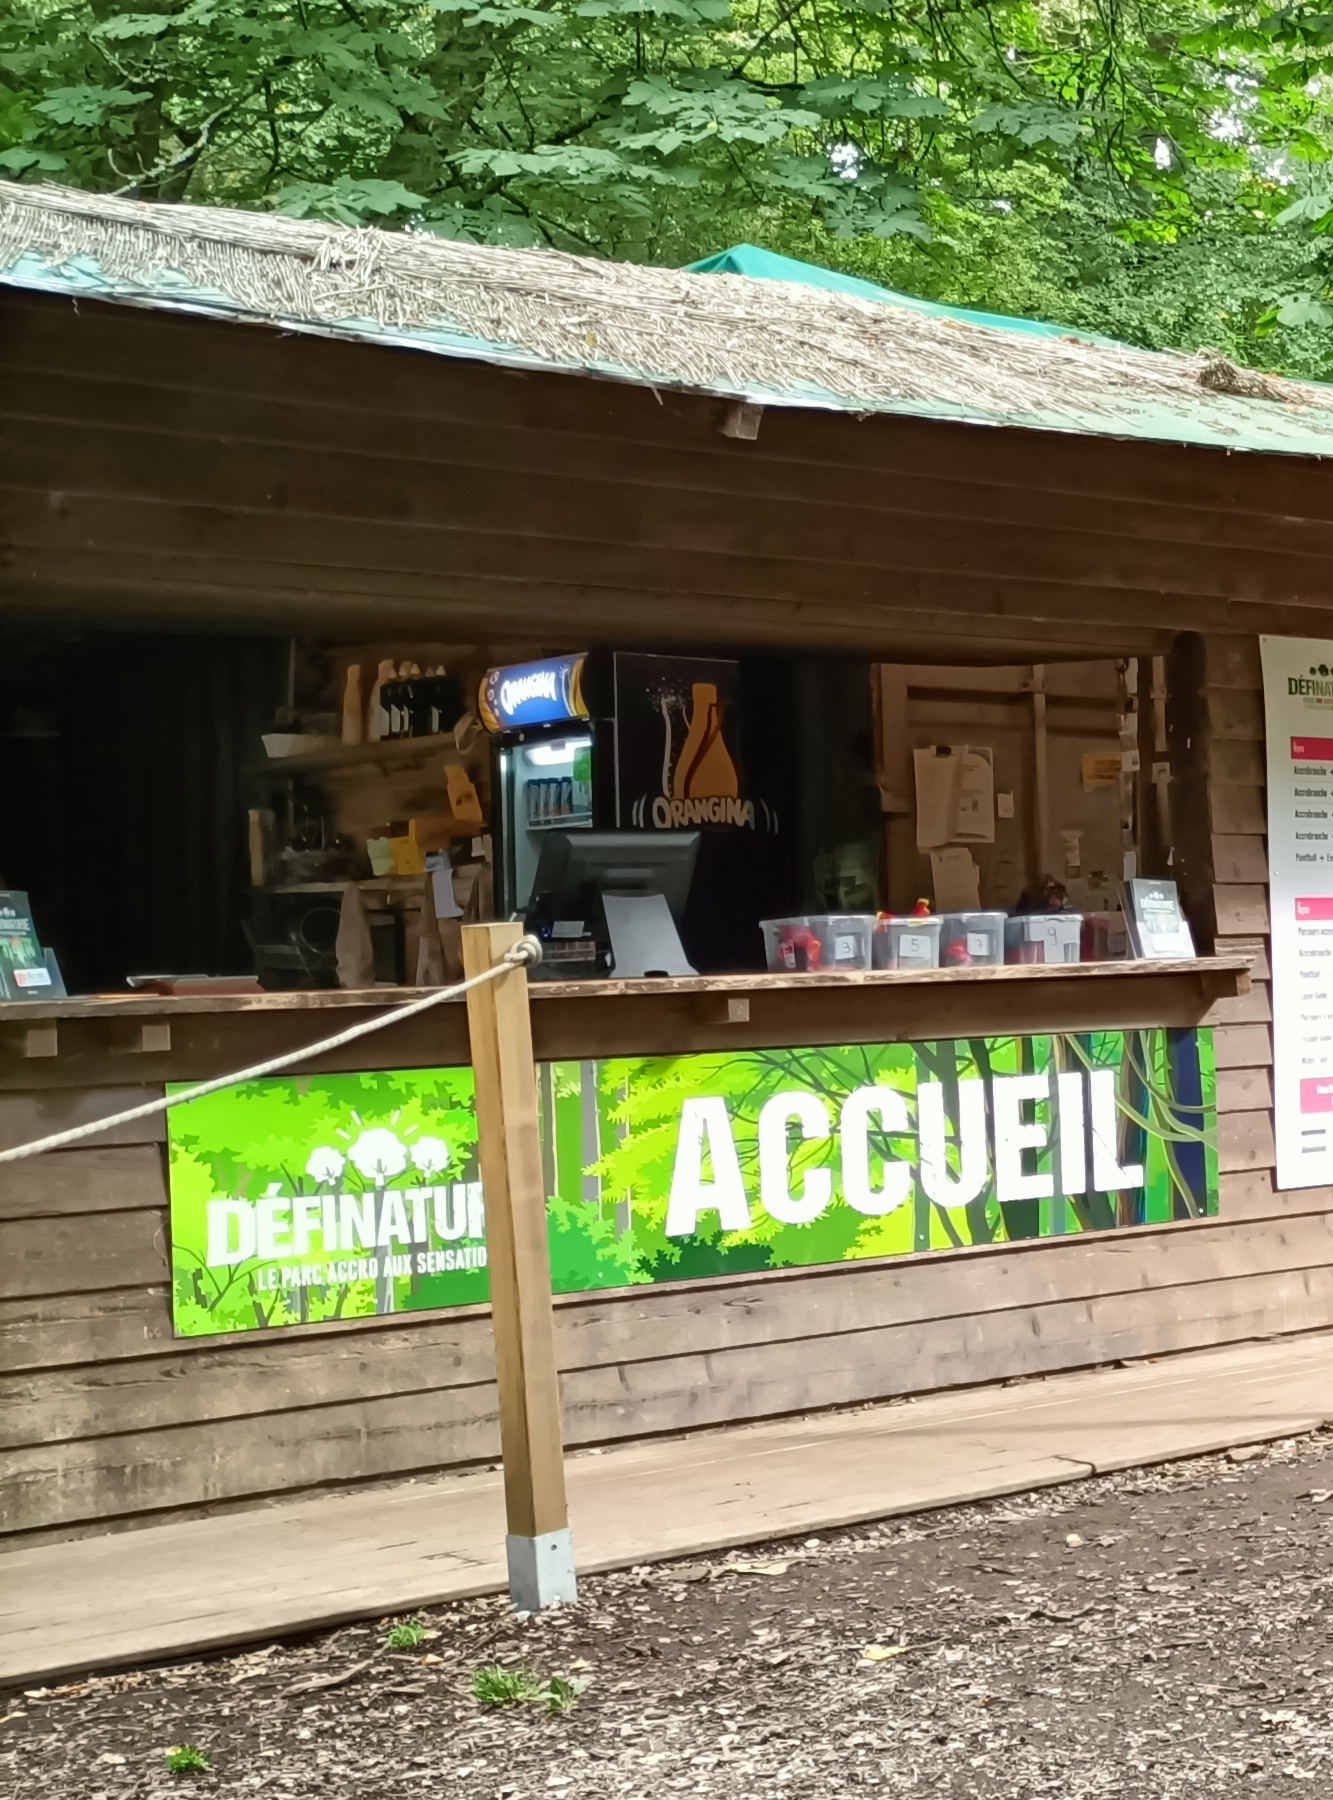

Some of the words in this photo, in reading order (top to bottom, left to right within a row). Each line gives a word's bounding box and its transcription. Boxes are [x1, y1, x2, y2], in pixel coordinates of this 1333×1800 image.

[500, 671, 557, 716] ORANGINA
[652, 797, 756, 830] ORANGINA
[842, 941, 851, 953] 3
[910, 938, 920, 952] 5
[1047, 928, 1058, 947] 9
[665, 1068, 1146, 1238] ACCUEIL
[205, 1182, 486, 1268] DÉFINATU
[257, 1268, 277, 1290] LE
[281, 1262, 323, 1288] PARC
[326, 1257, 379, 1284] ACCRO
[382, 1254, 413, 1278] AUX
[416, 1246, 488, 1273] SENSATIO
